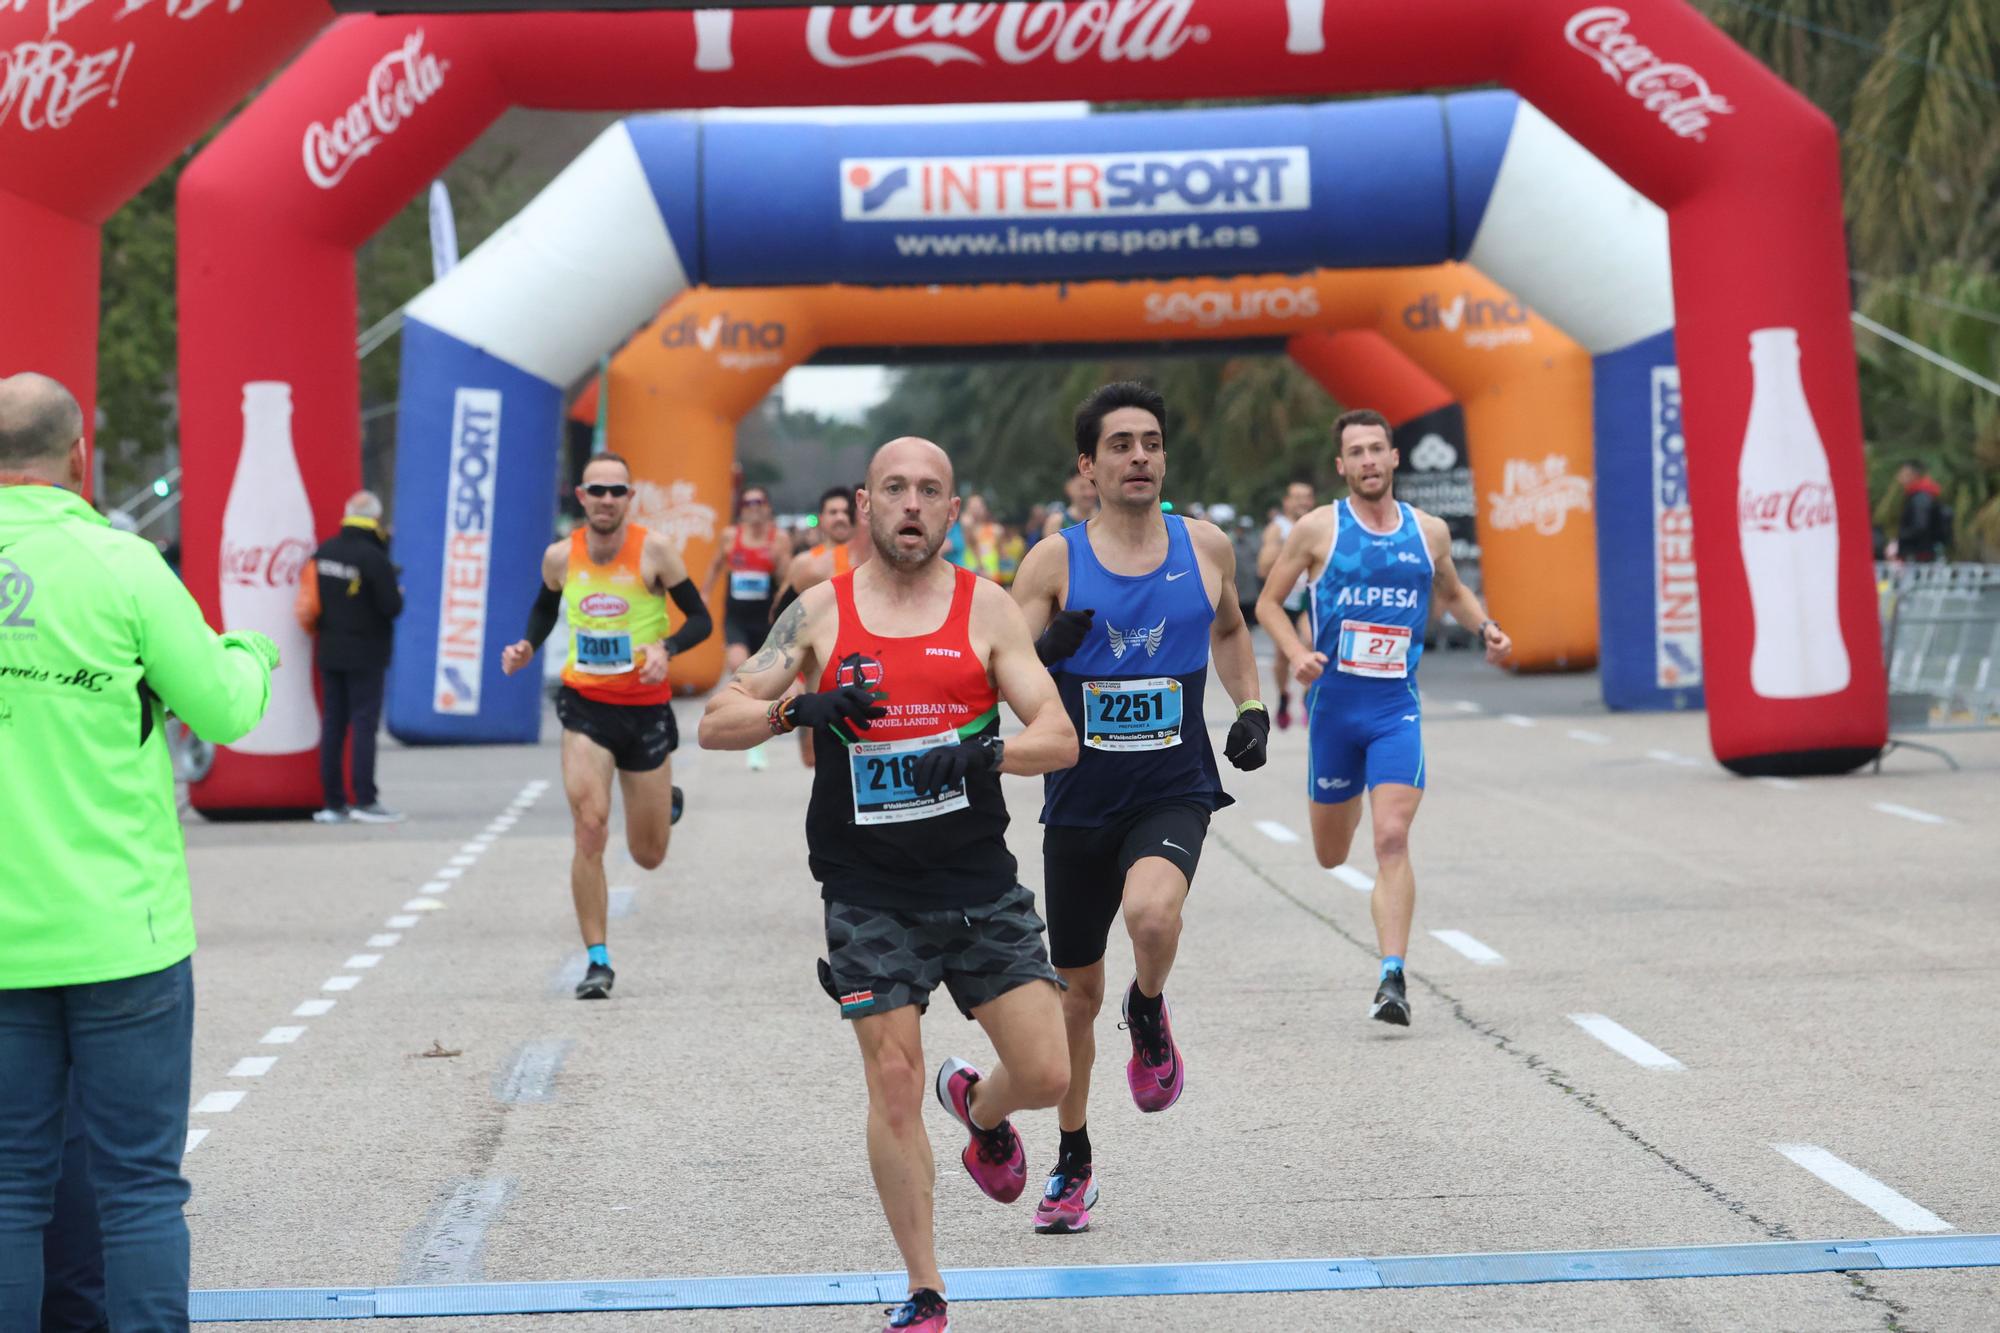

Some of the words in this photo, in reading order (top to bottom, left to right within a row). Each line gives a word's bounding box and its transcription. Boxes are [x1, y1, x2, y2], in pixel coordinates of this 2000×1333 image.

[920, 157, 1290, 213] INTERSPORT
[895, 222, 1260, 256] www.intersport.es
[1145, 286, 1320, 327] seguros
[443, 402, 493, 661] INTERSPORT
[1337, 586, 1418, 608] ALPESA
[925, 647, 961, 659] FASTER
[1369, 637, 1396, 656] 27
[867, 717, 902, 728] AQUEL
[903, 716, 939, 726] LANDIN
[905, 703, 947, 715] URBAN
[1099, 691, 1163, 722] 2251
[867, 755, 918, 791] 218
